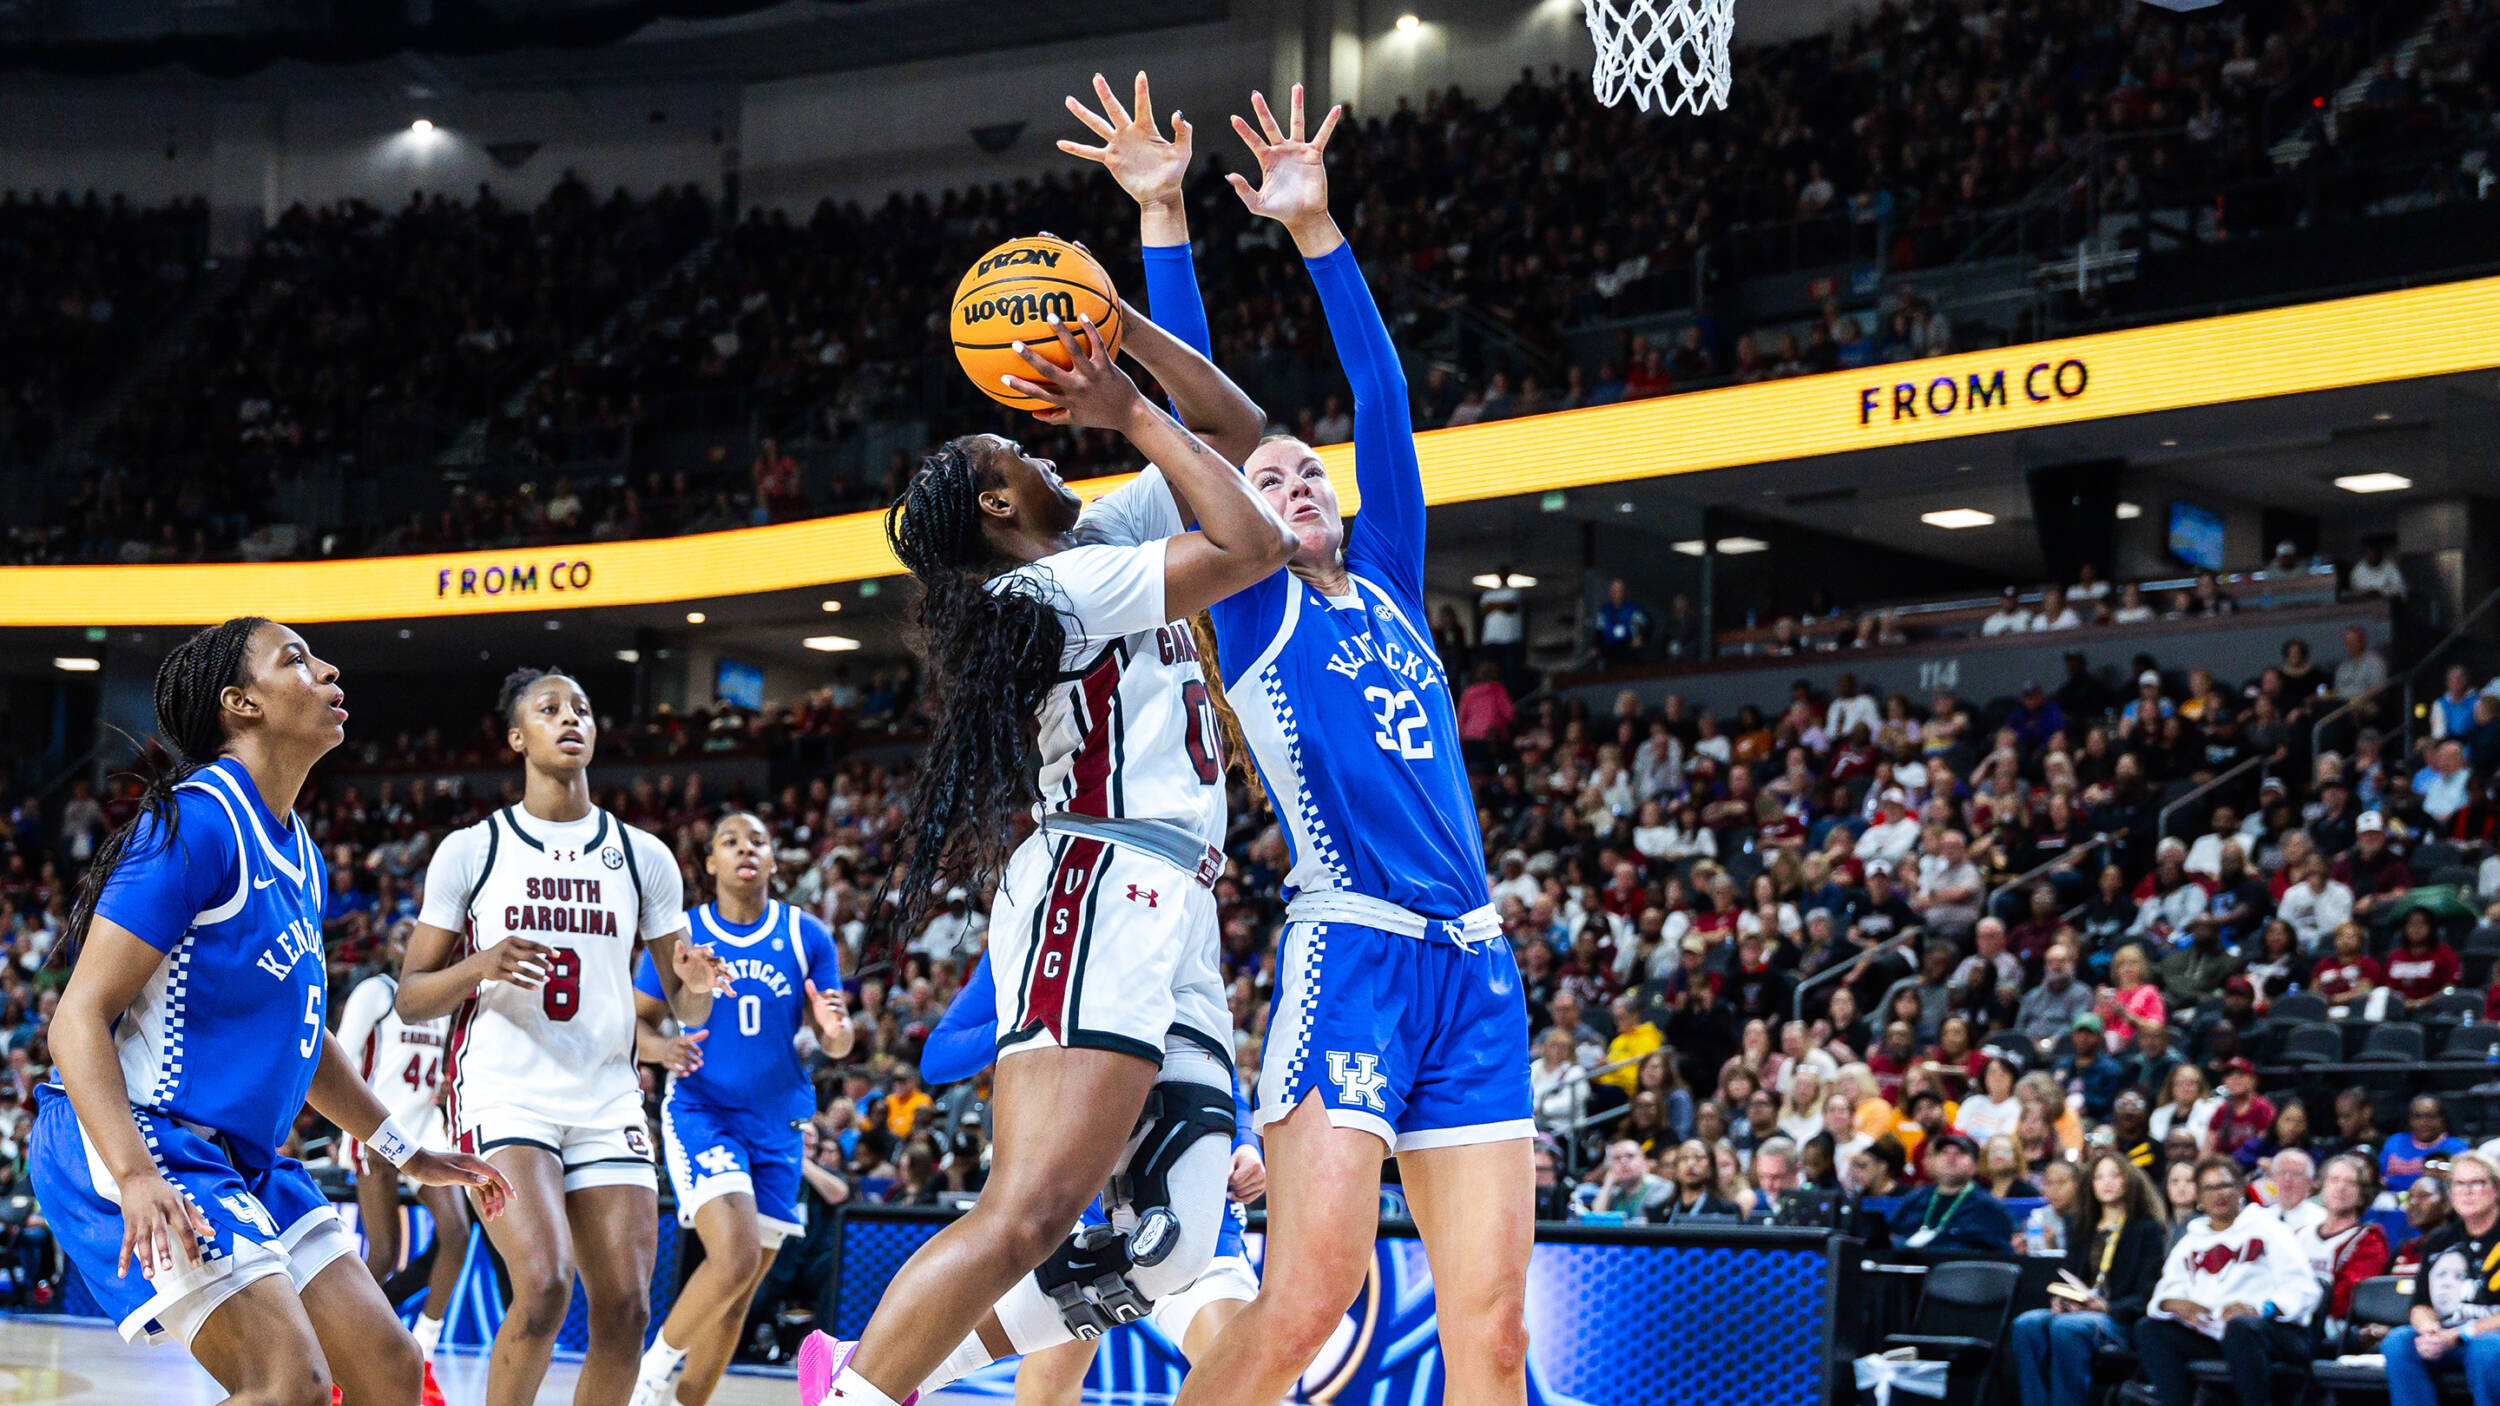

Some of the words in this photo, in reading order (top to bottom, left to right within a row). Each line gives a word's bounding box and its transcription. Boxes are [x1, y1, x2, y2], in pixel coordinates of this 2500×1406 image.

[977, 249, 1063, 278] NCAA
[963, 290, 1078, 326] Wilson
[1860, 369, 2007, 425] FROM
[2025, 359, 2088, 402] CO
[438, 564, 538, 597] FROM
[550, 560, 592, 591] CO
[1326, 632, 1438, 690] KENCKY
[1363, 685, 1434, 760] 32
[526, 877, 601, 904] SOUTH
[504, 904, 619, 938] CAROLINA
[542, 946, 581, 1022] 8
[299, 983, 322, 1060] 5
[738, 994, 761, 1037] 0
[402, 1052, 439, 1093] 44
[1325, 1050, 1388, 1113] UK
